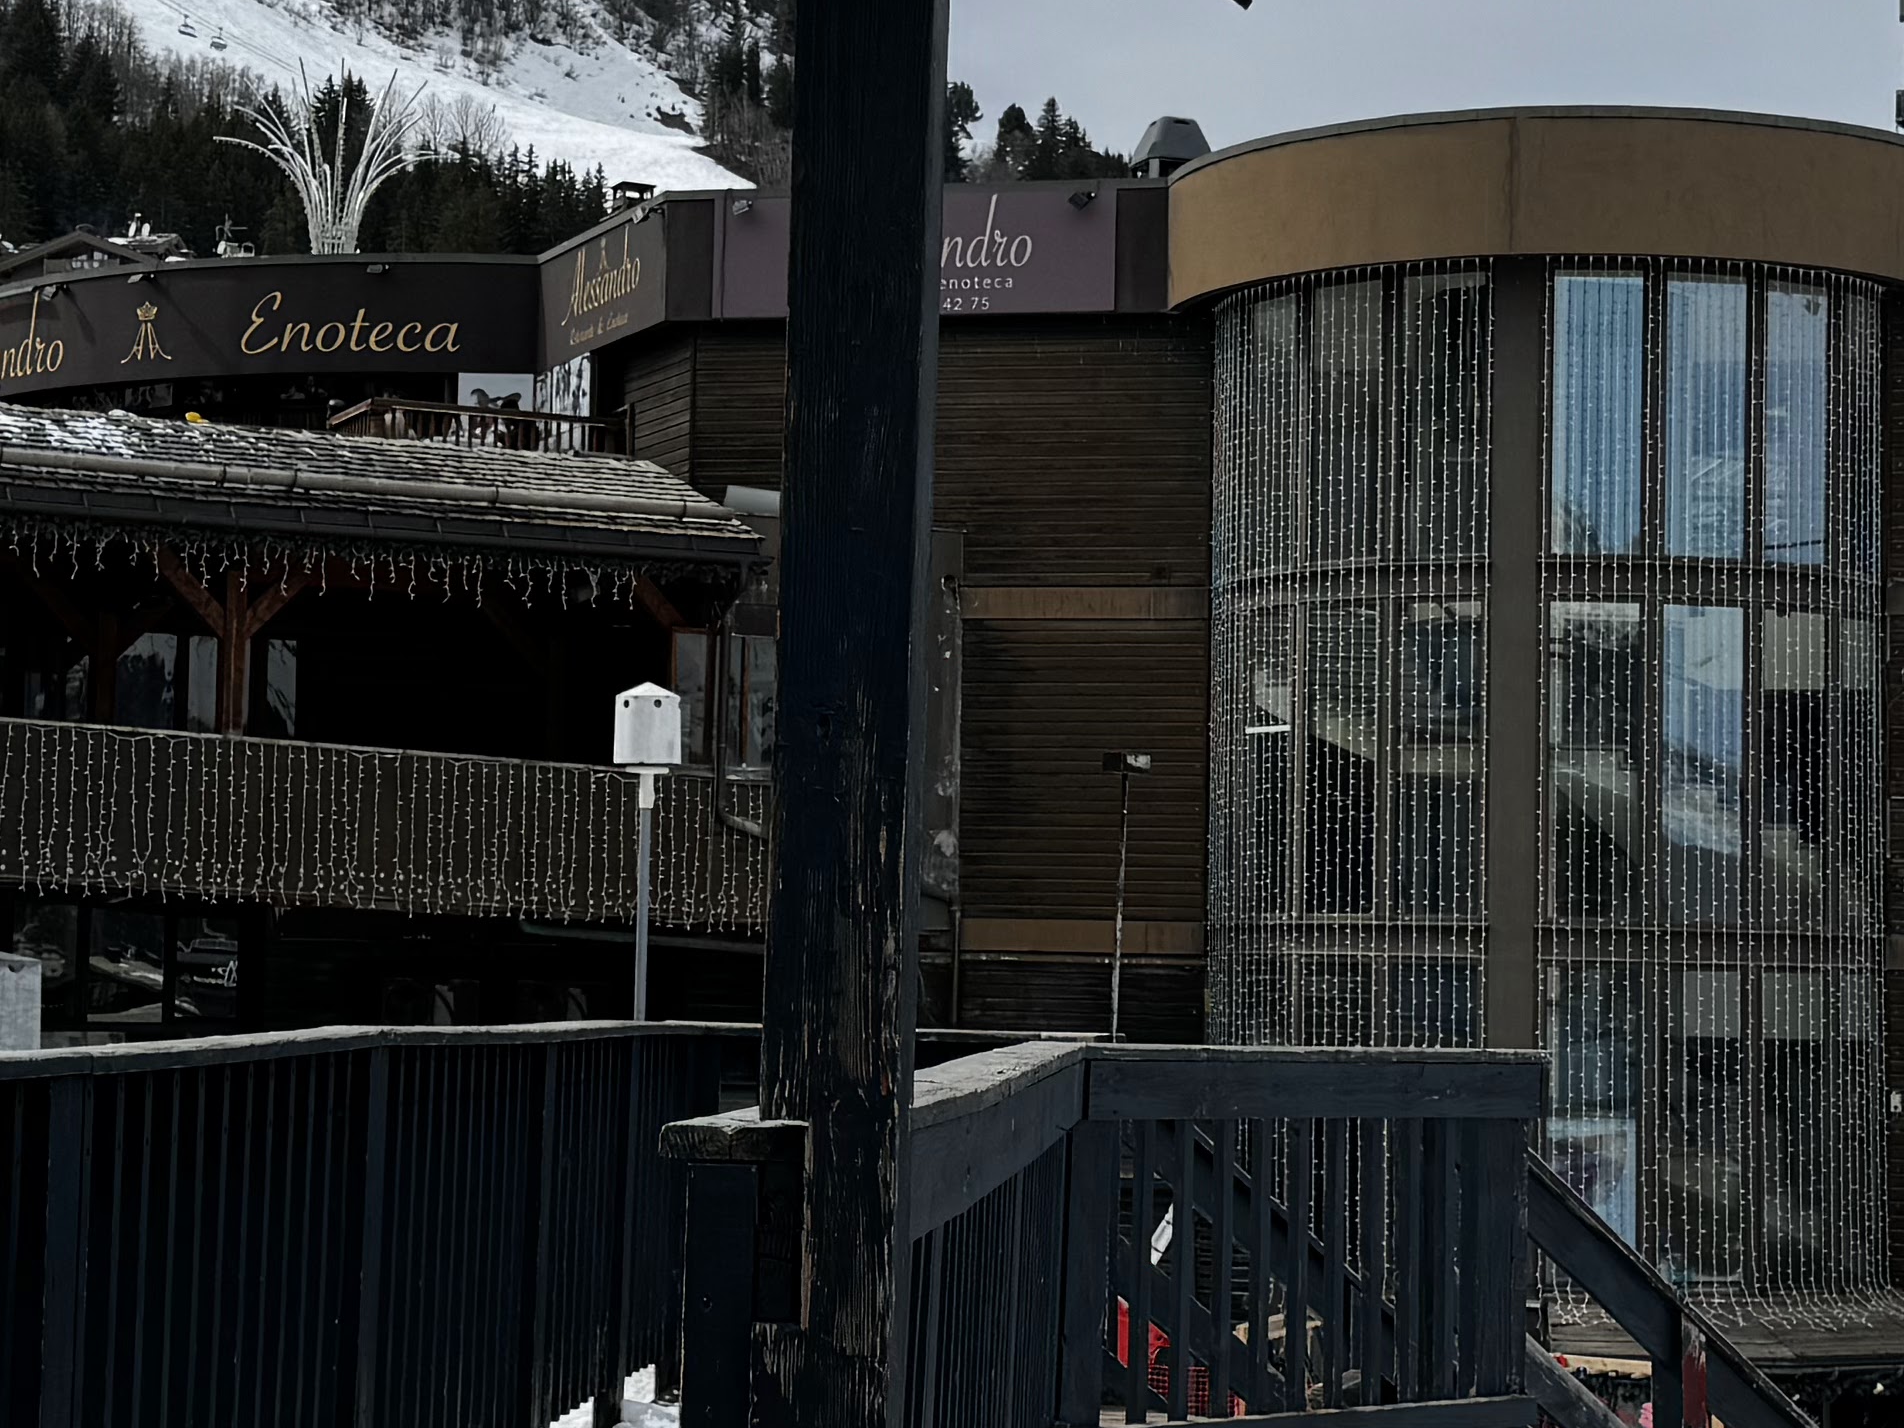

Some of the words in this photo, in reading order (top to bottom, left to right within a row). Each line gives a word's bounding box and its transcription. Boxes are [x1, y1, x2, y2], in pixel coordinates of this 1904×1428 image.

[561, 225, 641, 326] Alessandro
[942, 297, 963, 311] 42
[971, 296, 991, 311] 75
[241, 291, 461, 356] Enoteca
